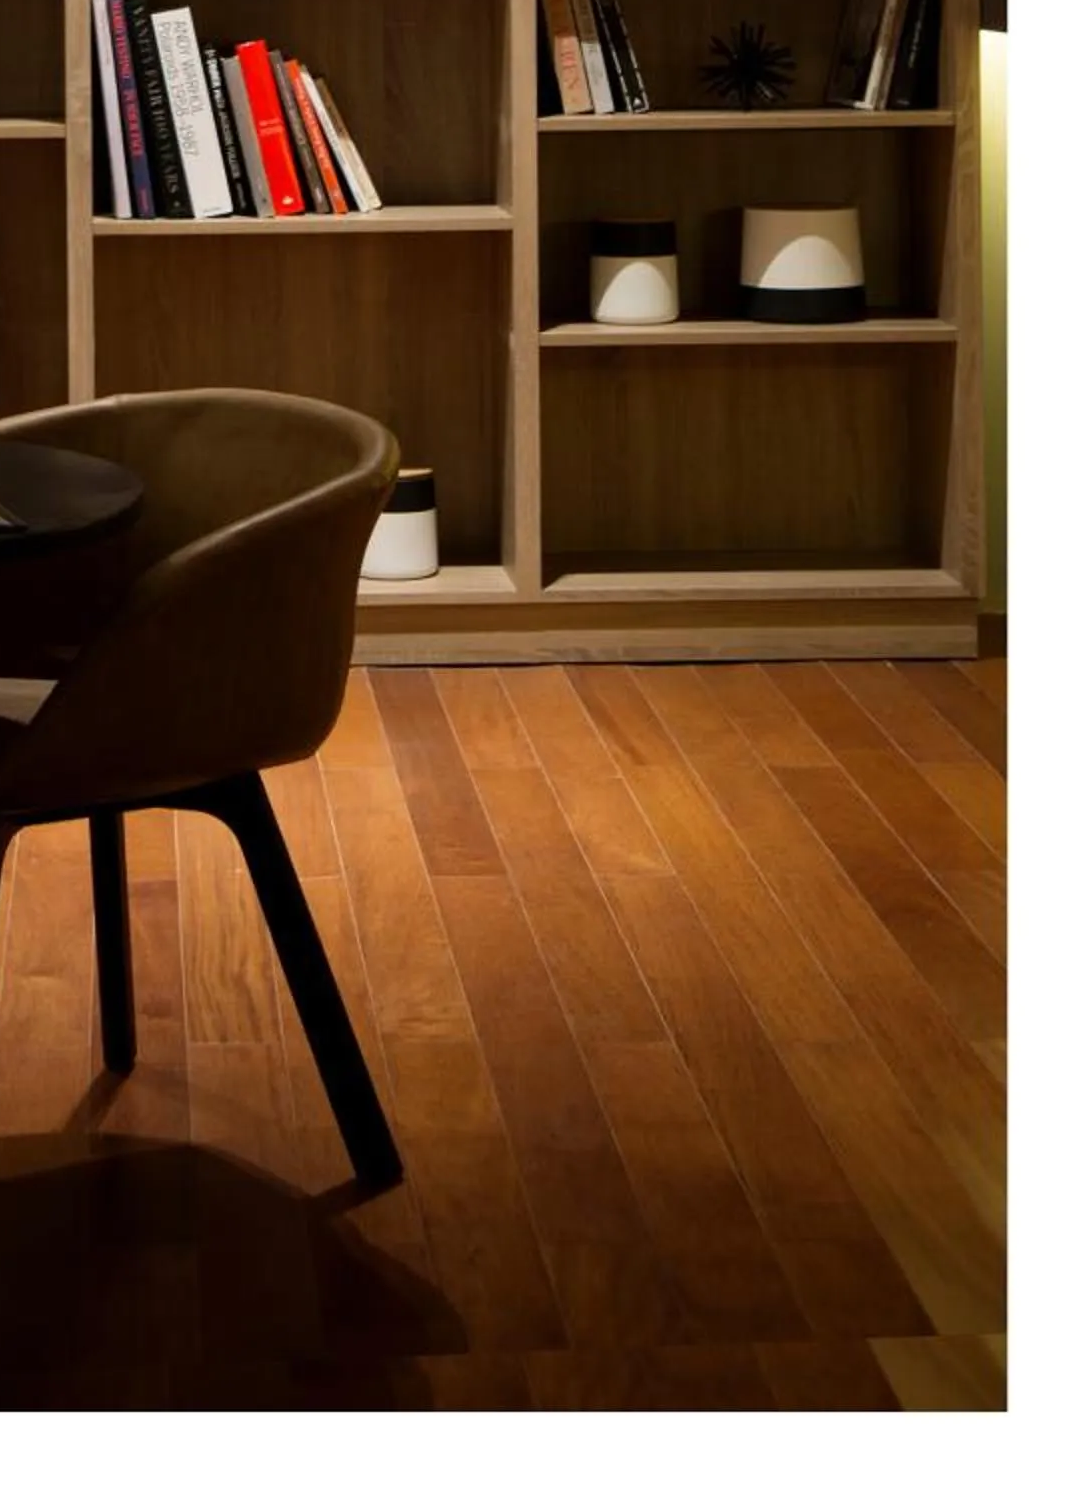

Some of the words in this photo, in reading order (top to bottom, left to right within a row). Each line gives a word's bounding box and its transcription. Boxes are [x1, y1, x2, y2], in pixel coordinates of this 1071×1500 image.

[131, 4, 156, 65] VANITY
[172, 19, 194, 56] ANDY
[143, 68, 164, 106] FAIR
[179, 58, 206, 114] WARHOL
[158, 141, 181, 194] YEARS
